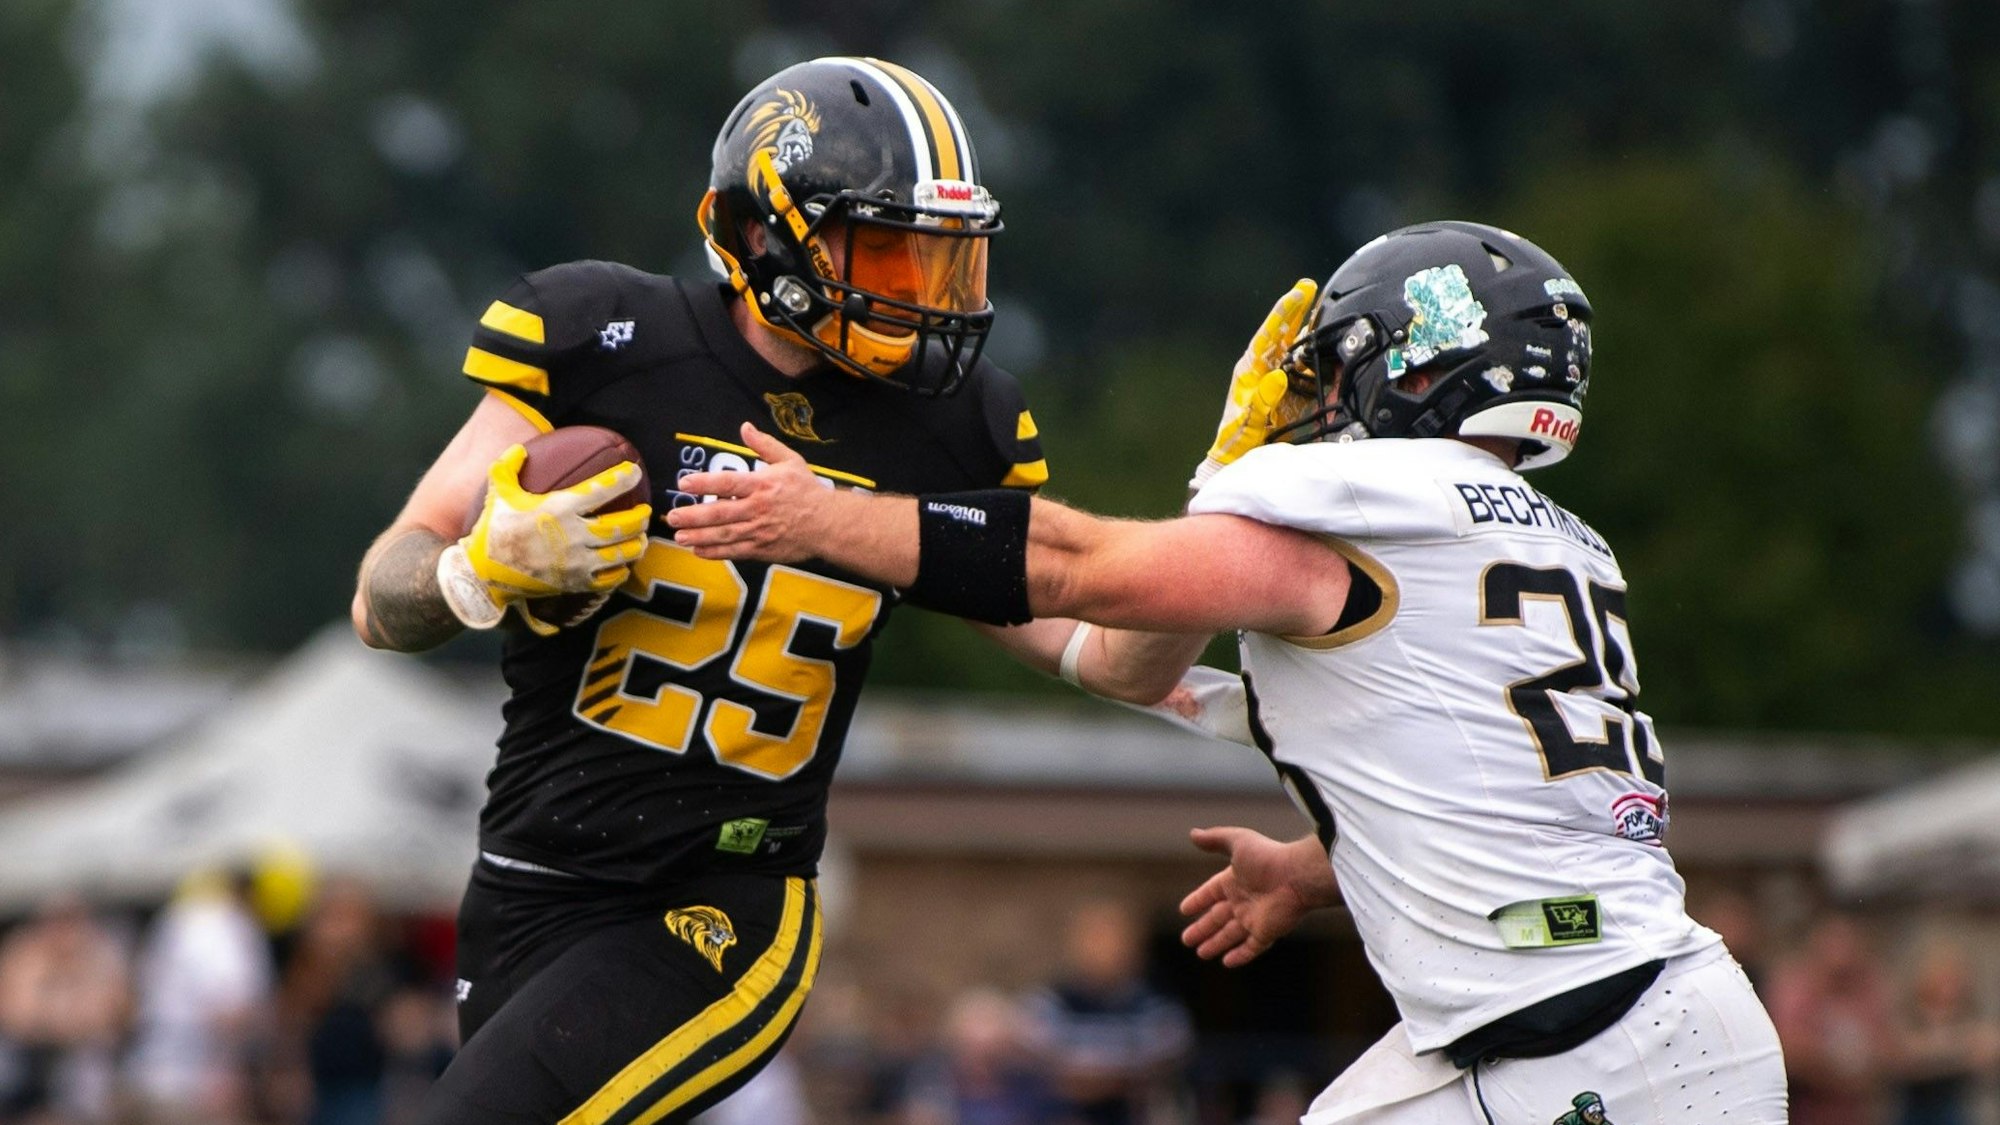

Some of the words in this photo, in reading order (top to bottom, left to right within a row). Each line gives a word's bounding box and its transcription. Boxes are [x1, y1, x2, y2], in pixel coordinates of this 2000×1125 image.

[936, 184, 972, 201] Riddell
[809, 243, 836, 280] Ridd
[1530, 407, 1579, 446] Ridd
[927, 502, 987, 526] Wilson
[573, 536, 882, 781] 25
